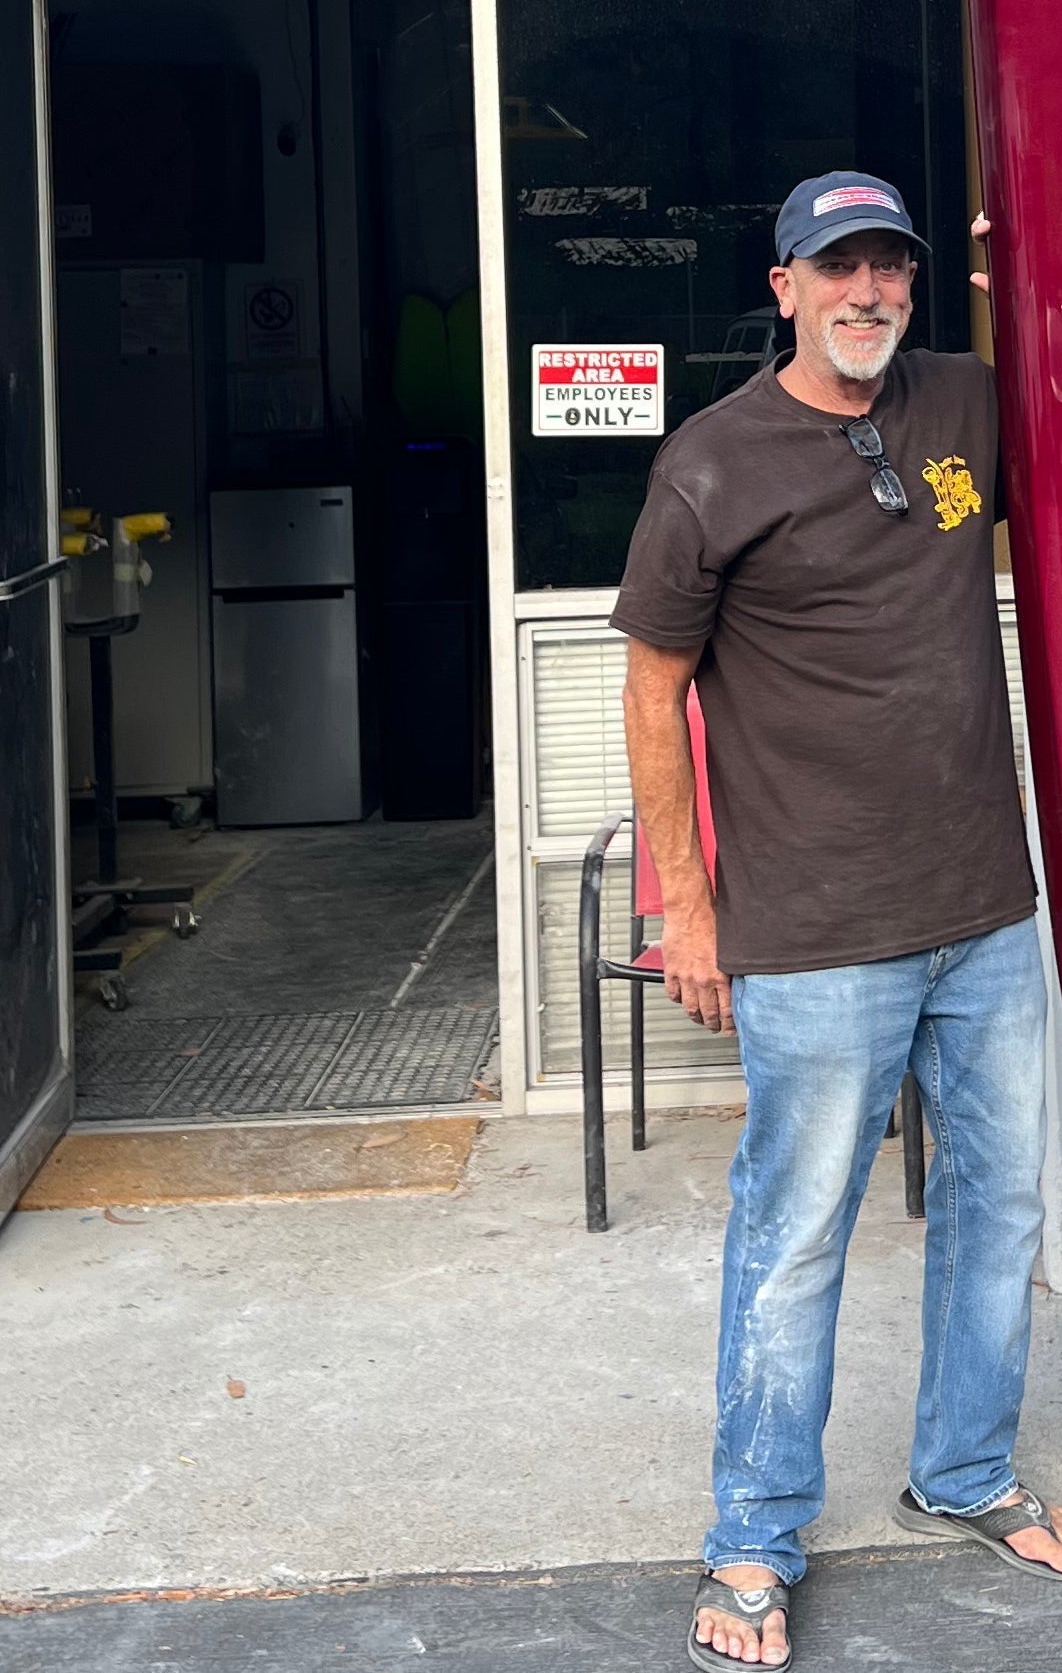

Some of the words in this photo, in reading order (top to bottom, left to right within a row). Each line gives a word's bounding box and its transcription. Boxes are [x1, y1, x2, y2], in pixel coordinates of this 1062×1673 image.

[539, 353, 657, 367] RESTRICTED
[572, 368, 624, 383] AREA
[545, 387, 652, 401] EMPLOYEES
[565, 407, 634, 426] ONLY
